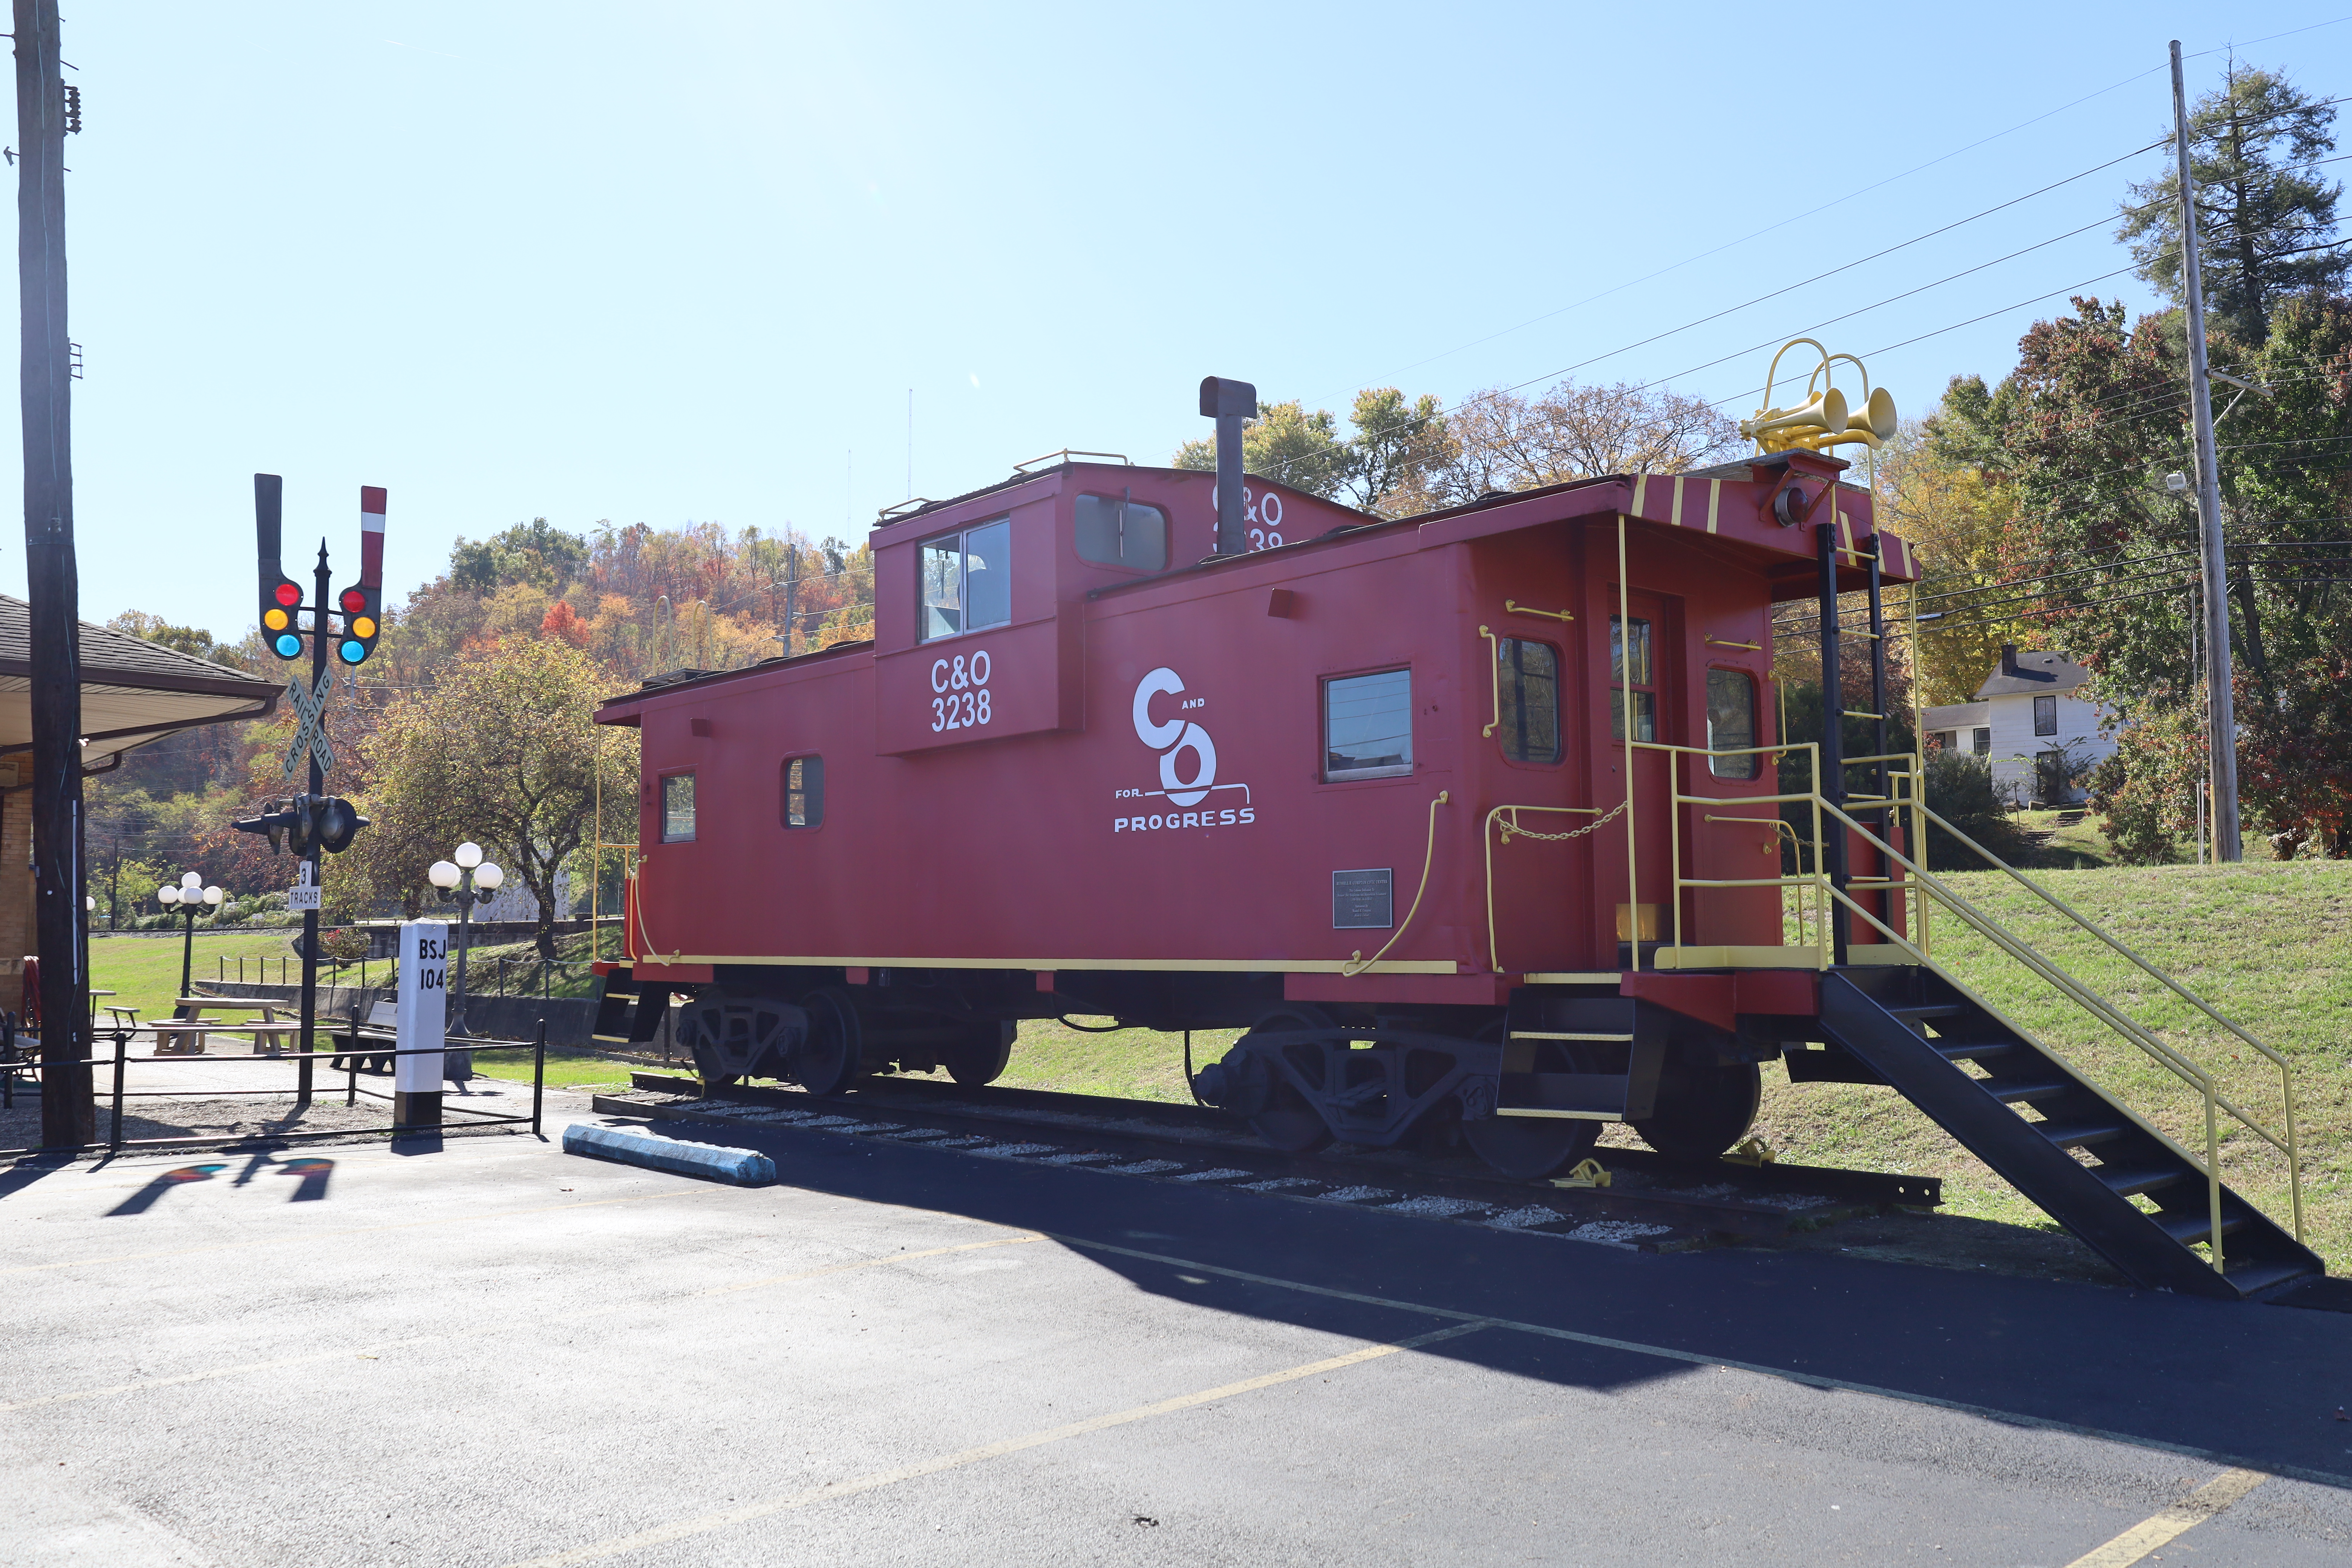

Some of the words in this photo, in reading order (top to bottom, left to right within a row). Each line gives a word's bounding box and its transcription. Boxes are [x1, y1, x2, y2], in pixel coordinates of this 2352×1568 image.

[931, 650, 991, 693] C&O
[932, 689, 991, 732] 3238
[1182, 698, 1205, 709] AND
[286, 675, 329, 773] CROSSING
[1116, 789, 1144, 798] FOR
[1115, 808, 1255, 833] PROGRESS
[302, 868, 306, 884] 3
[291, 891, 317, 904] TRACKS
[420, 939, 446, 960] BSJ
[421, 969, 444, 990] 104
